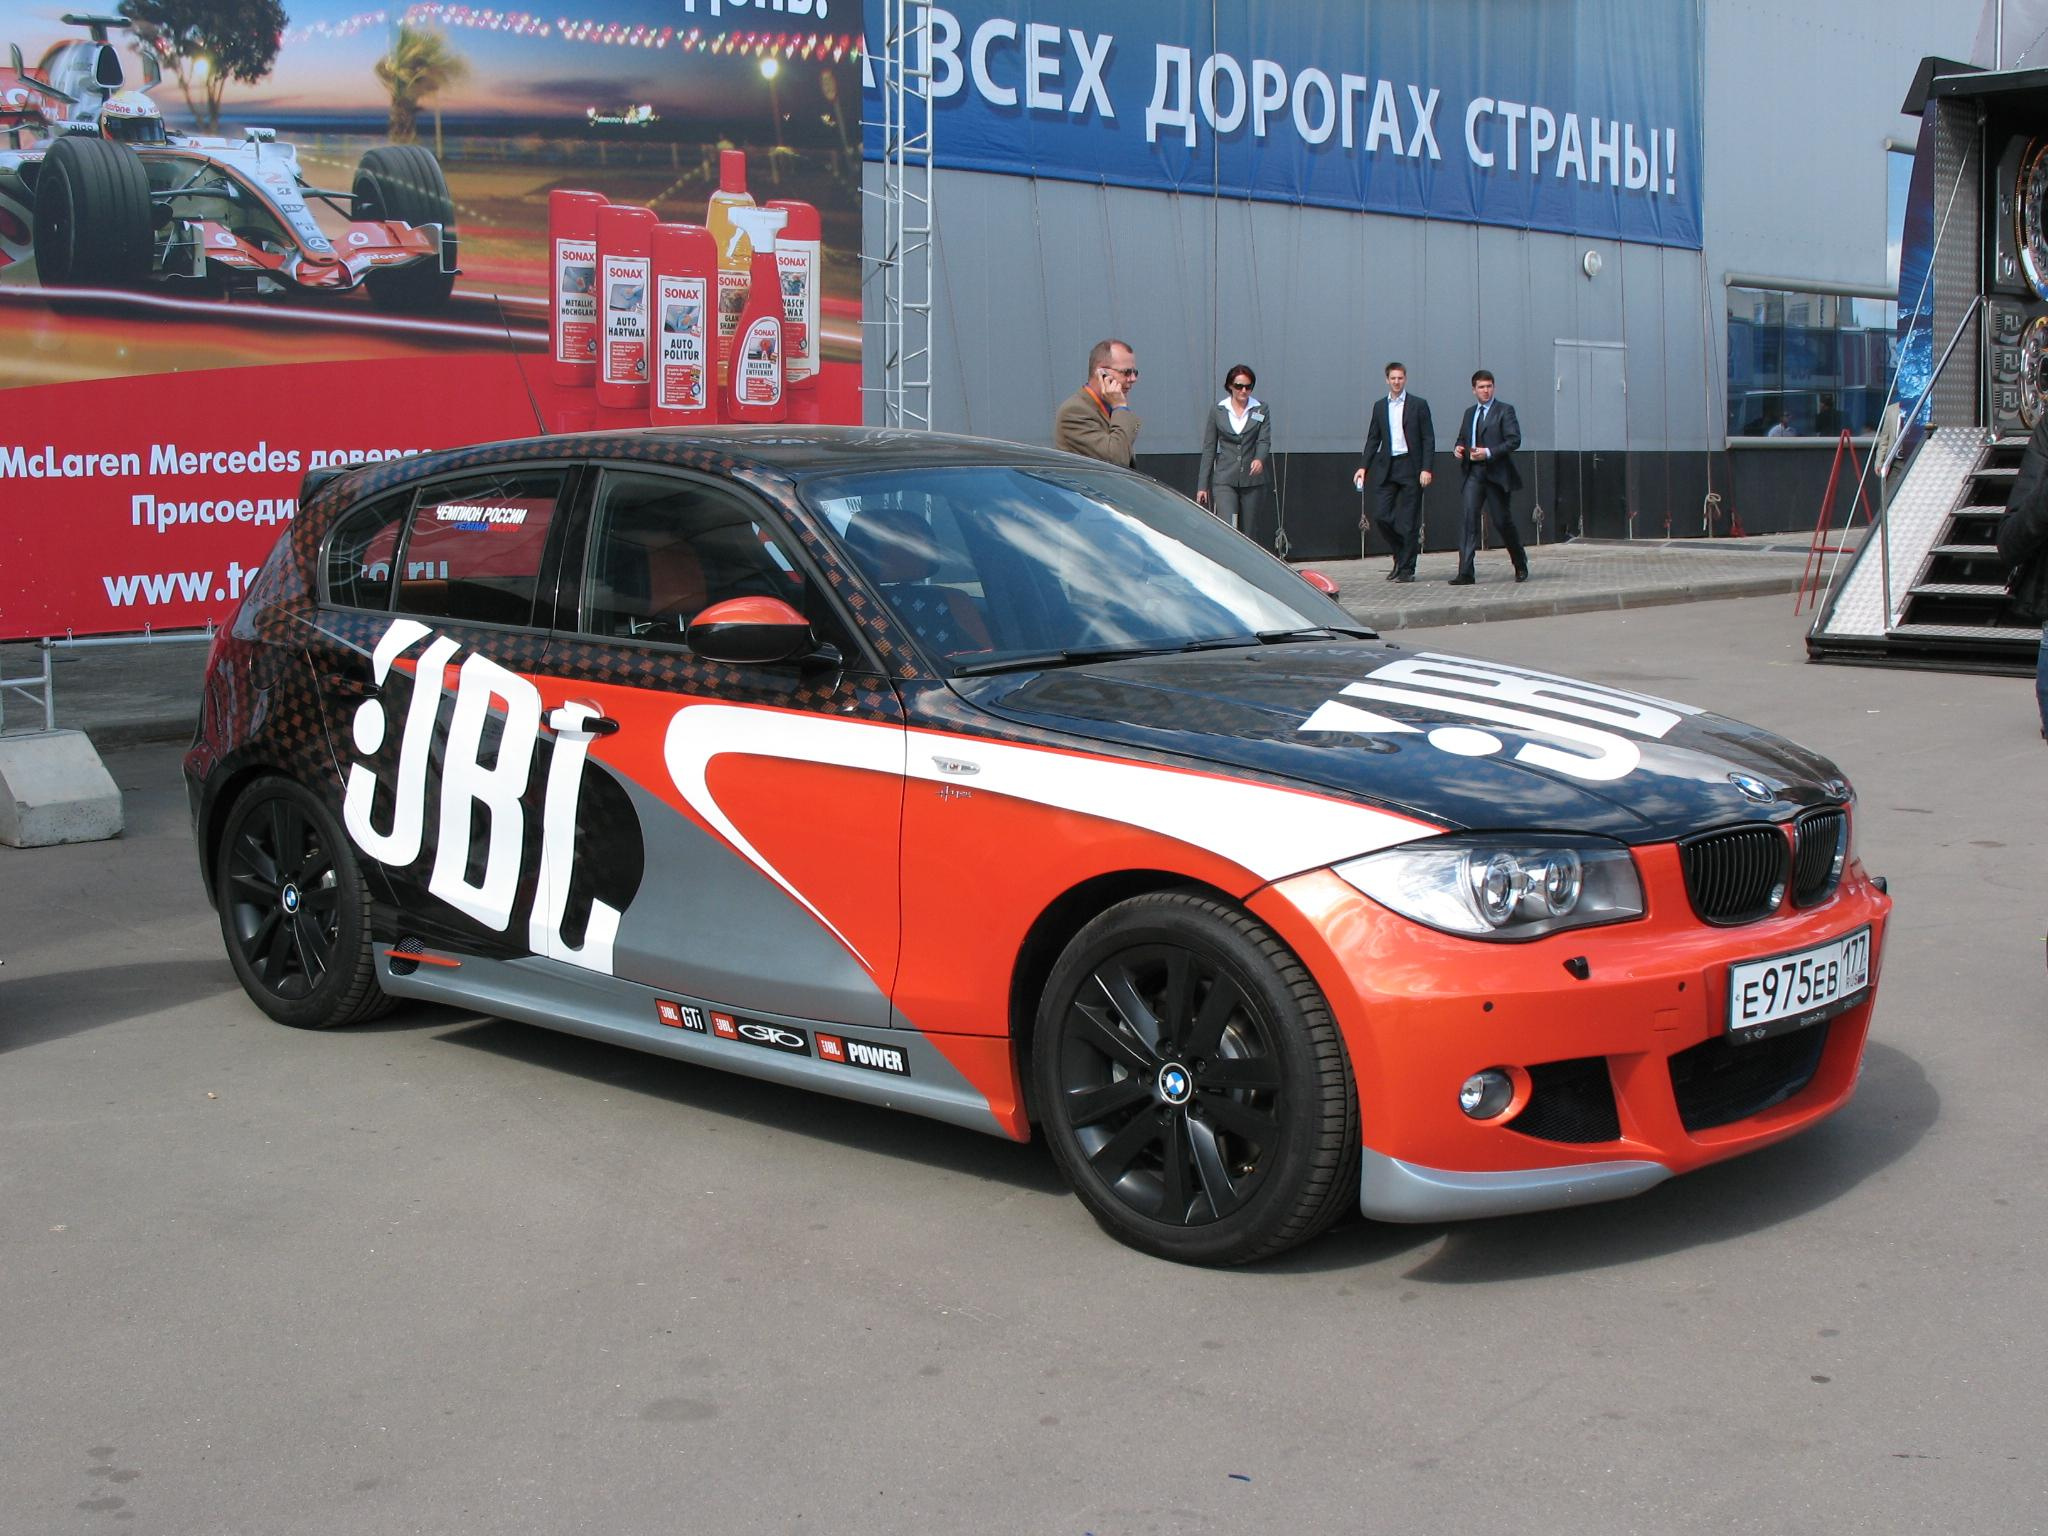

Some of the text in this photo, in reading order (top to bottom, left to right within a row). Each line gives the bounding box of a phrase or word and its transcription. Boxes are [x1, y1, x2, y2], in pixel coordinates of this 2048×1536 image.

[916, 5, 1116, 119] ВСЕХ
[1145, 43, 1442, 160] ДОРОГАХ
[1464, 96, 1676, 195] СТРАНЫ!
[562, 250, 595, 262] SONAX
[778, 257, 807, 267] SONAX
[609, 267, 643, 279] SONAX
[718, 276, 748, 287] SONAX
[664, 287, 699, 300] SONAX
[565, 299, 593, 308] METALLIC
[616, 317, 637, 327] AUTO
[608, 326, 645, 337] HARTWAX
[754, 329, 776, 337] SONAX
[670, 338, 693, 349] AUTO
[664, 349, 699, 360] POLITUR
[0, 445, 140, 478] McLaren
[150, 441, 300, 475] Mercedes
[436, 505, 528, 524] ЧЕМПИОН РОССИИ
[660, 1005, 704, 1030] JBL GTi
[715, 1017, 805, 1048] JBL GTO
[821, 1039, 904, 1072] JBL POWER
